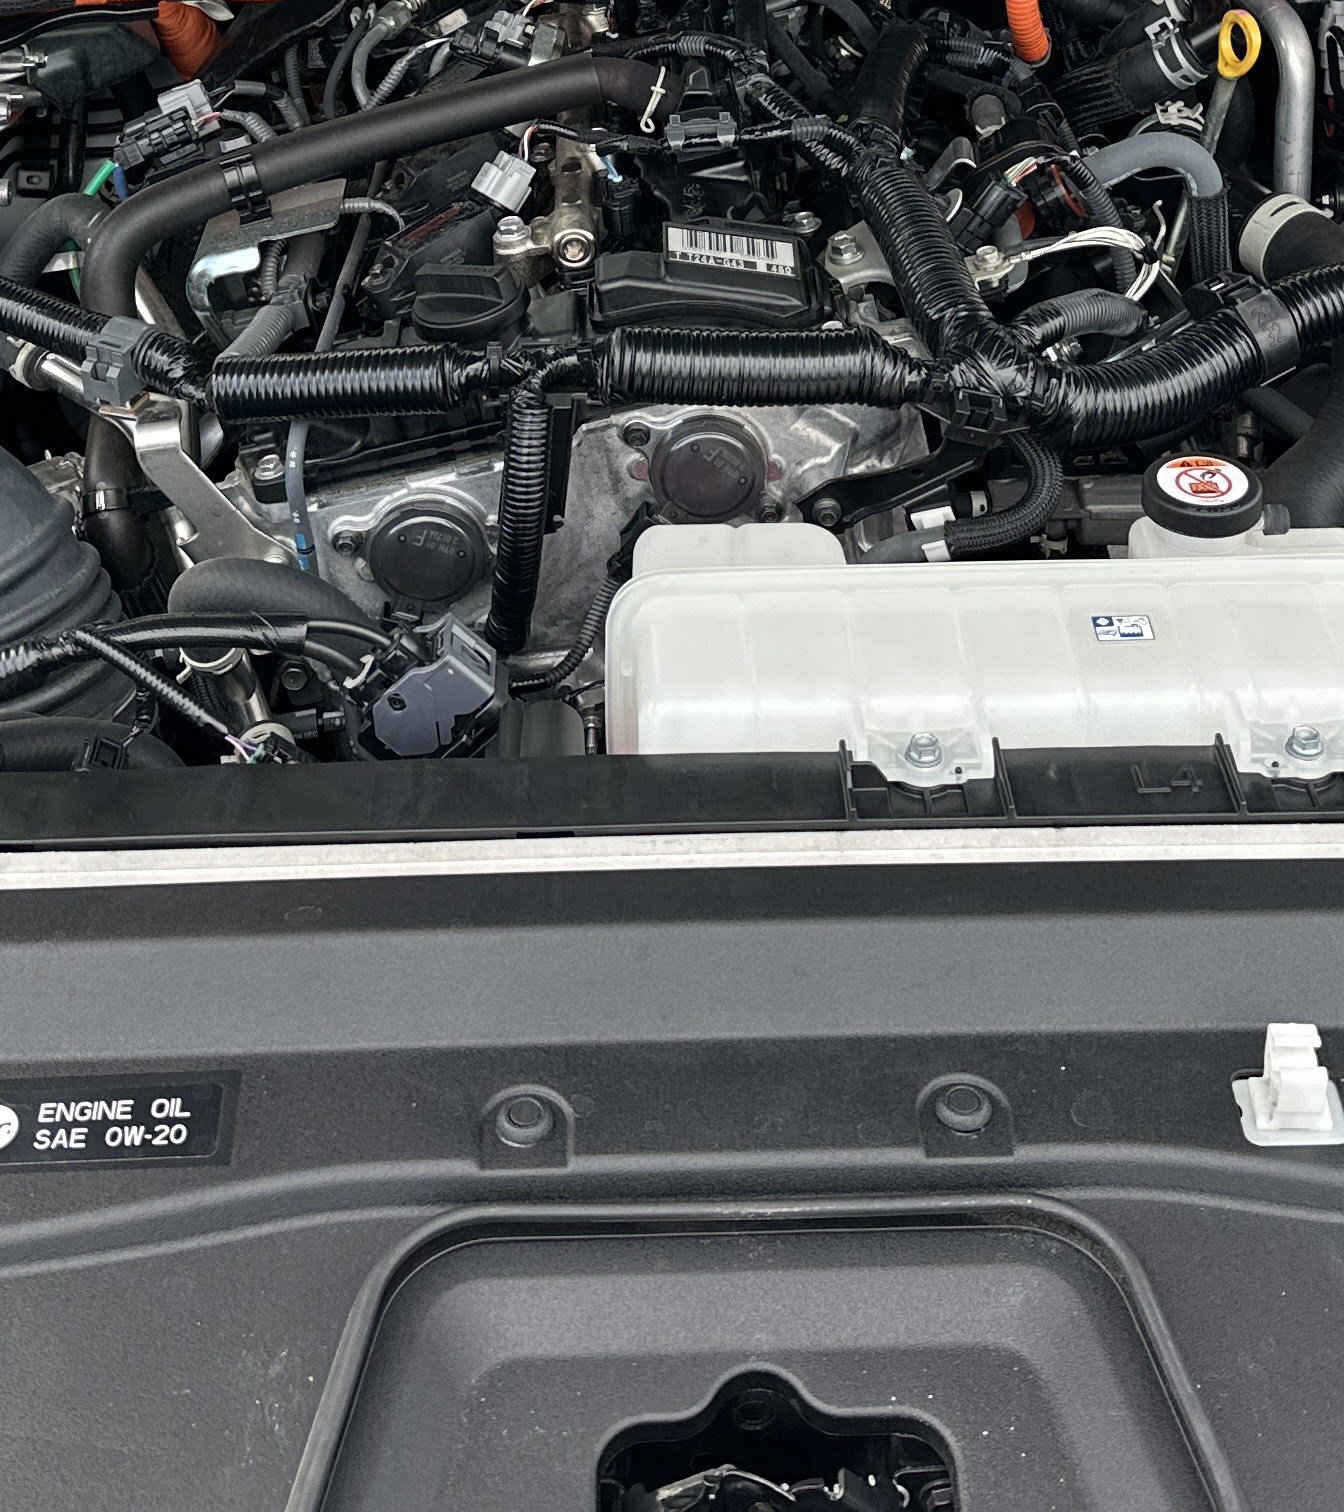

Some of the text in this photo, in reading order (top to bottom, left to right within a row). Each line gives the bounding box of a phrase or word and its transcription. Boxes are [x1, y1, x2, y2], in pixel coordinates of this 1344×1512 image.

[1129, 763, 1203, 794] L4
[37, 1097, 191, 1123] ENGINE OIL
[32, 1123, 188, 1150] SAE 0W-20
